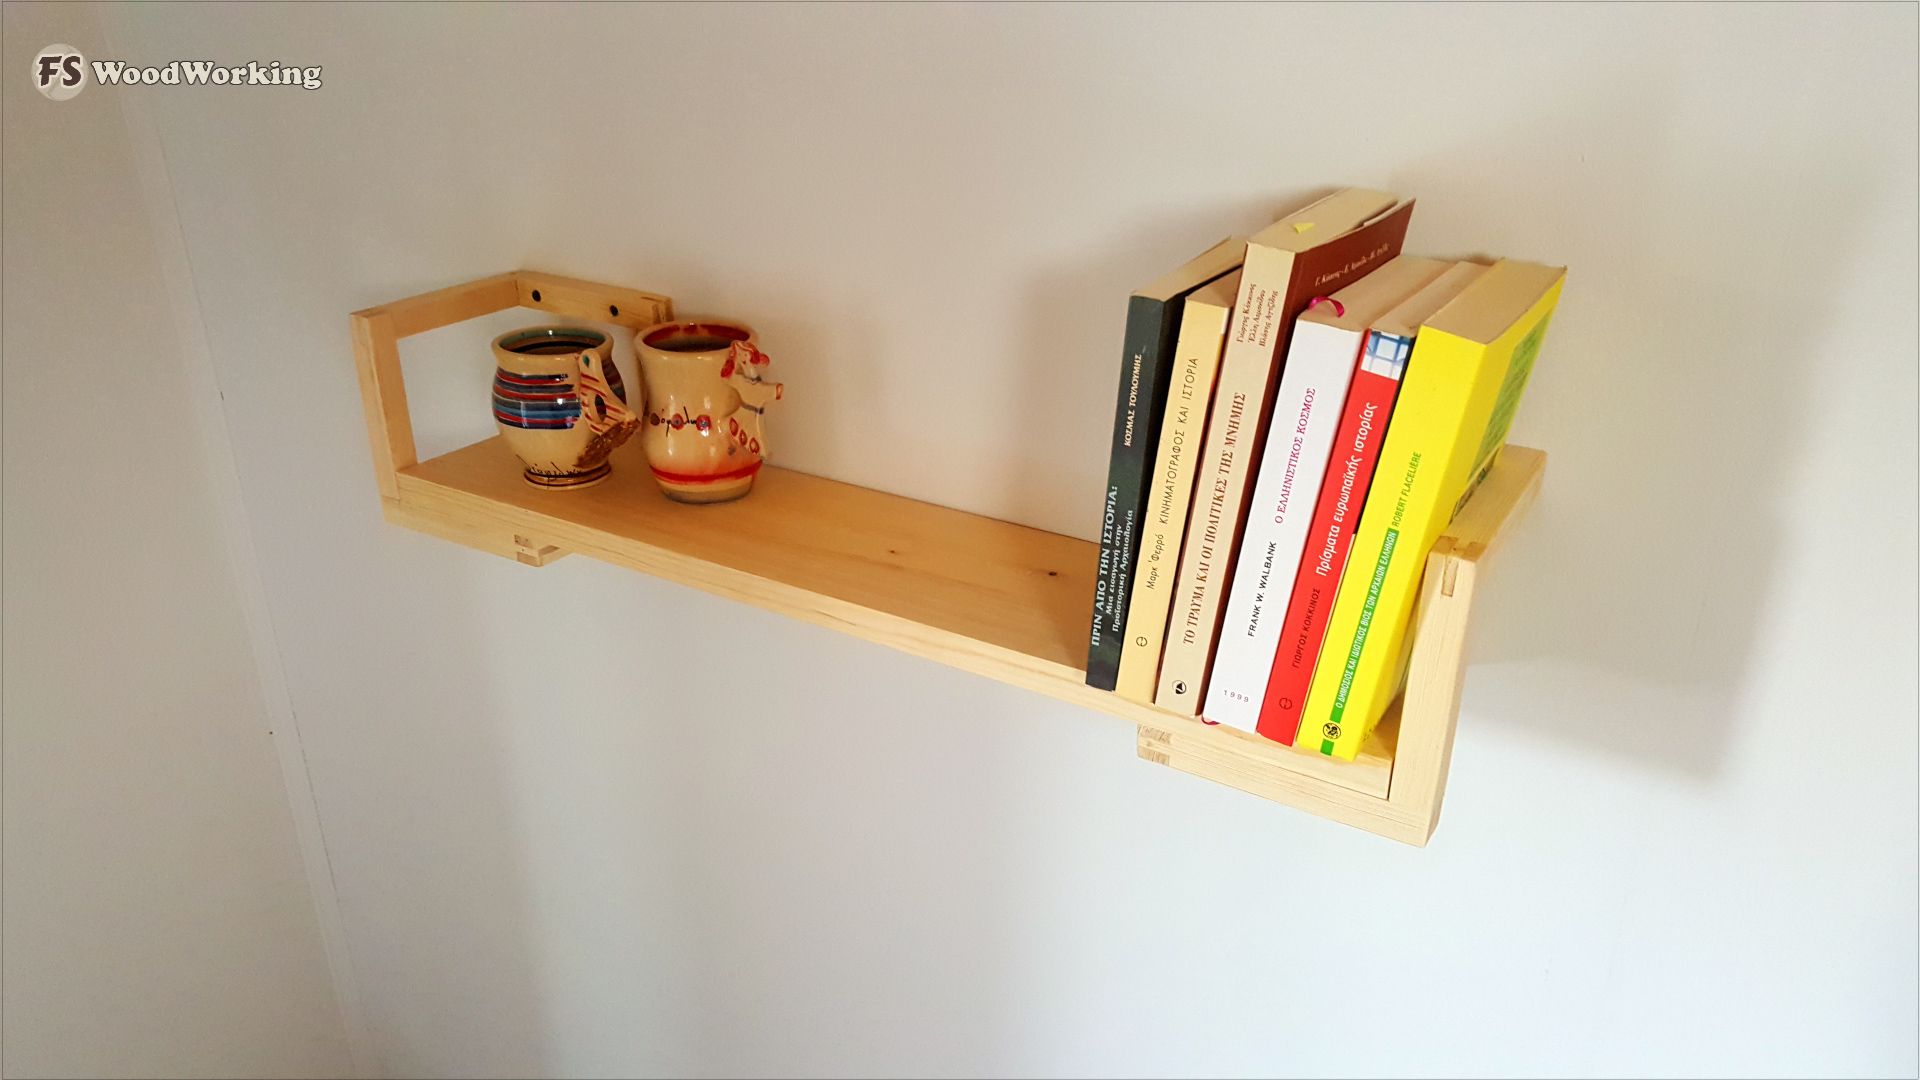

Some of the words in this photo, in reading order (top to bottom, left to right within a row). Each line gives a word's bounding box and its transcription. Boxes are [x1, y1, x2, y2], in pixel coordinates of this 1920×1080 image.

[1129, 353, 1142, 407] ΤΟΥΛΟΥΜΗΣ
[1182, 357, 1199, 400] ΙΣΤΟΡΙΑ
[1124, 409, 1135, 447] ΚΟΣΜΑΣ
[1177, 406, 1189, 424] ΚΑΙ
[1224, 392, 1246, 448] ΜΝΗΜΗΣ
[1218, 450, 1234, 475] ΤΗΣ
[1276, 436, 1303, 514] ΕΛΛΗΝΙΣΤΙΚΟΣ
[1296, 387, 1316, 435] ΚΟΣΜΟΣ
[1159, 429, 1185, 524] ΚΙΝΗΜΑΤΟΓΡΑΦΟΣ
[1315, 525, 1341, 577] Πρίσματα
[1333, 455, 1363, 523] ευρωπαϊκής
[1353, 402, 1378, 453] ιστορίας
[1102, 486, 1118, 544] ΙΣΤΟΡΙΑ:
[1204, 478, 1228, 544] ΠΟΛΙΤΙΚΕΣ
[1391, 496, 1408, 527] ROBERT
[1098, 548, 1110, 576] ΤΗΝ
[1201, 546, 1214, 559] ΟΙ
[1258, 541, 1277, 590] WALBANK
[1146, 567, 1160, 589] Μαρκ
[1196, 562, 1210, 583] ΚΑΙ
[1095, 580, 1107, 611] ΑΠΟ
[1187, 586, 1205, 628] ΤΡΑΥΜΑ
[1255, 592, 1265, 603] W.
[1091, 614, 1103, 647] ΠΡΙΝ
[1183, 629, 1196, 645] ΤΟ
[1247, 605, 1262, 637] FRANK
[1292, 634, 1308, 669] ΓΙΩΡΓΟΣ
[1302, 588, 1321, 632] ΚΟΚΚΙΝΟΣ
